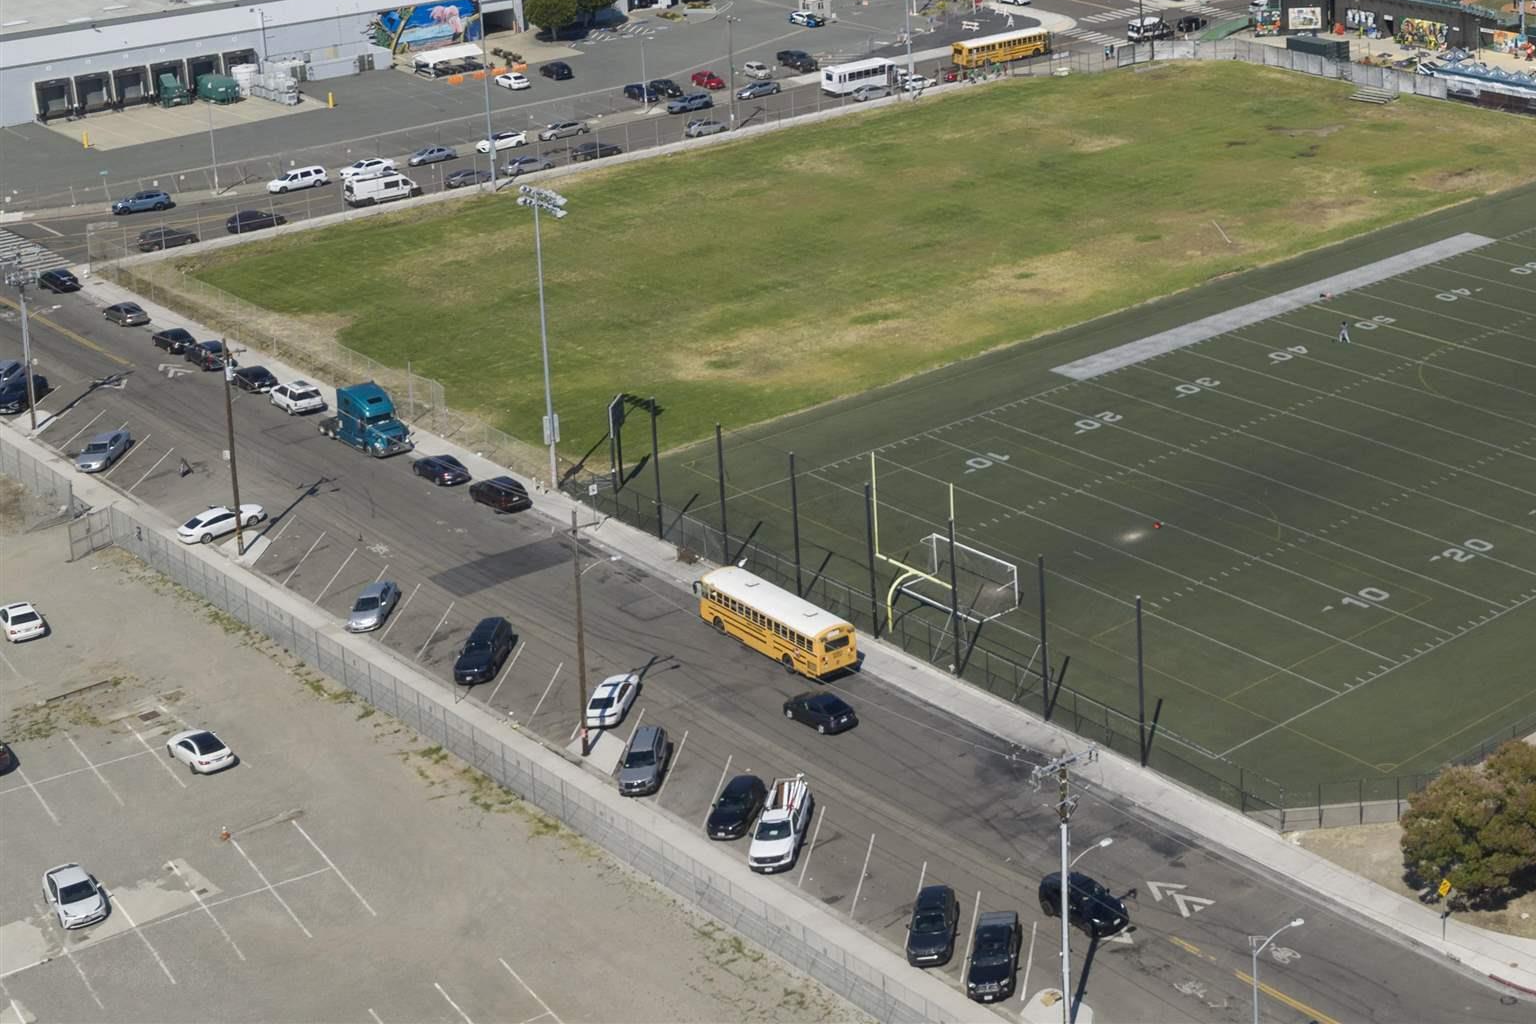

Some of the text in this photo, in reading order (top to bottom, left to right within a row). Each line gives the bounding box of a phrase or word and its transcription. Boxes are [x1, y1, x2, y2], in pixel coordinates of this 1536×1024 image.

[1435, 288, 1471, 302] 40
[1354, 315, 1397, 330] 50
[1268, 345, 1309, 361] 40
[1175, 377, 1220, 394] 30
[1074, 411, 1123, 430] 20
[965, 452, 1010, 469] 10
[1442, 538, 1494, 562] 20
[1342, 587, 1390, 608] 10
